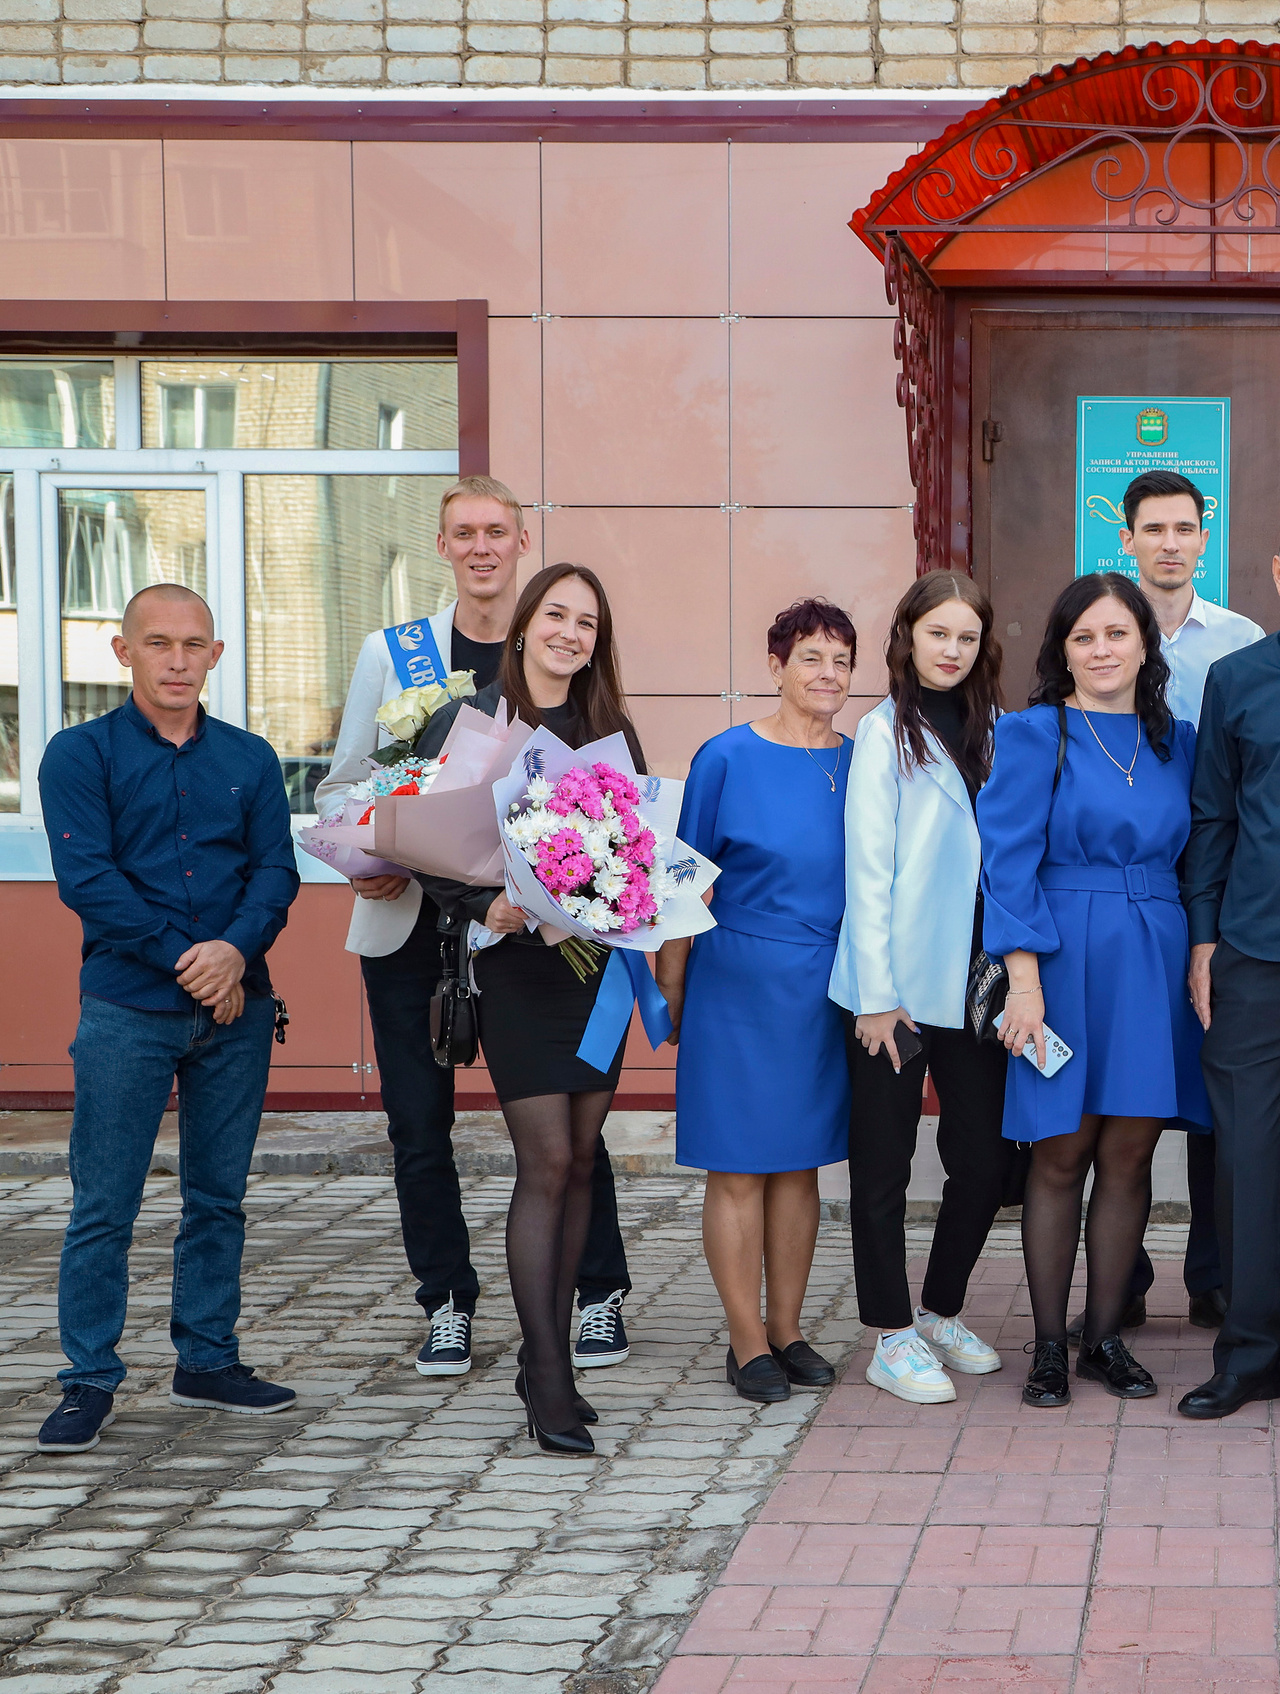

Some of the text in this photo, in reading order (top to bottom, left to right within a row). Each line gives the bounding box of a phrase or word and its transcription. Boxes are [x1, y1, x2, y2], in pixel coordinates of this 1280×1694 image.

[1151, 459, 1216, 467] ГРАЖДАНСКОГО
[1181, 467, 1219, 475] ОБЛАСТИ
[1097, 558, 1114, 567] ПО
[1117, 558, 1126, 567] Г.
